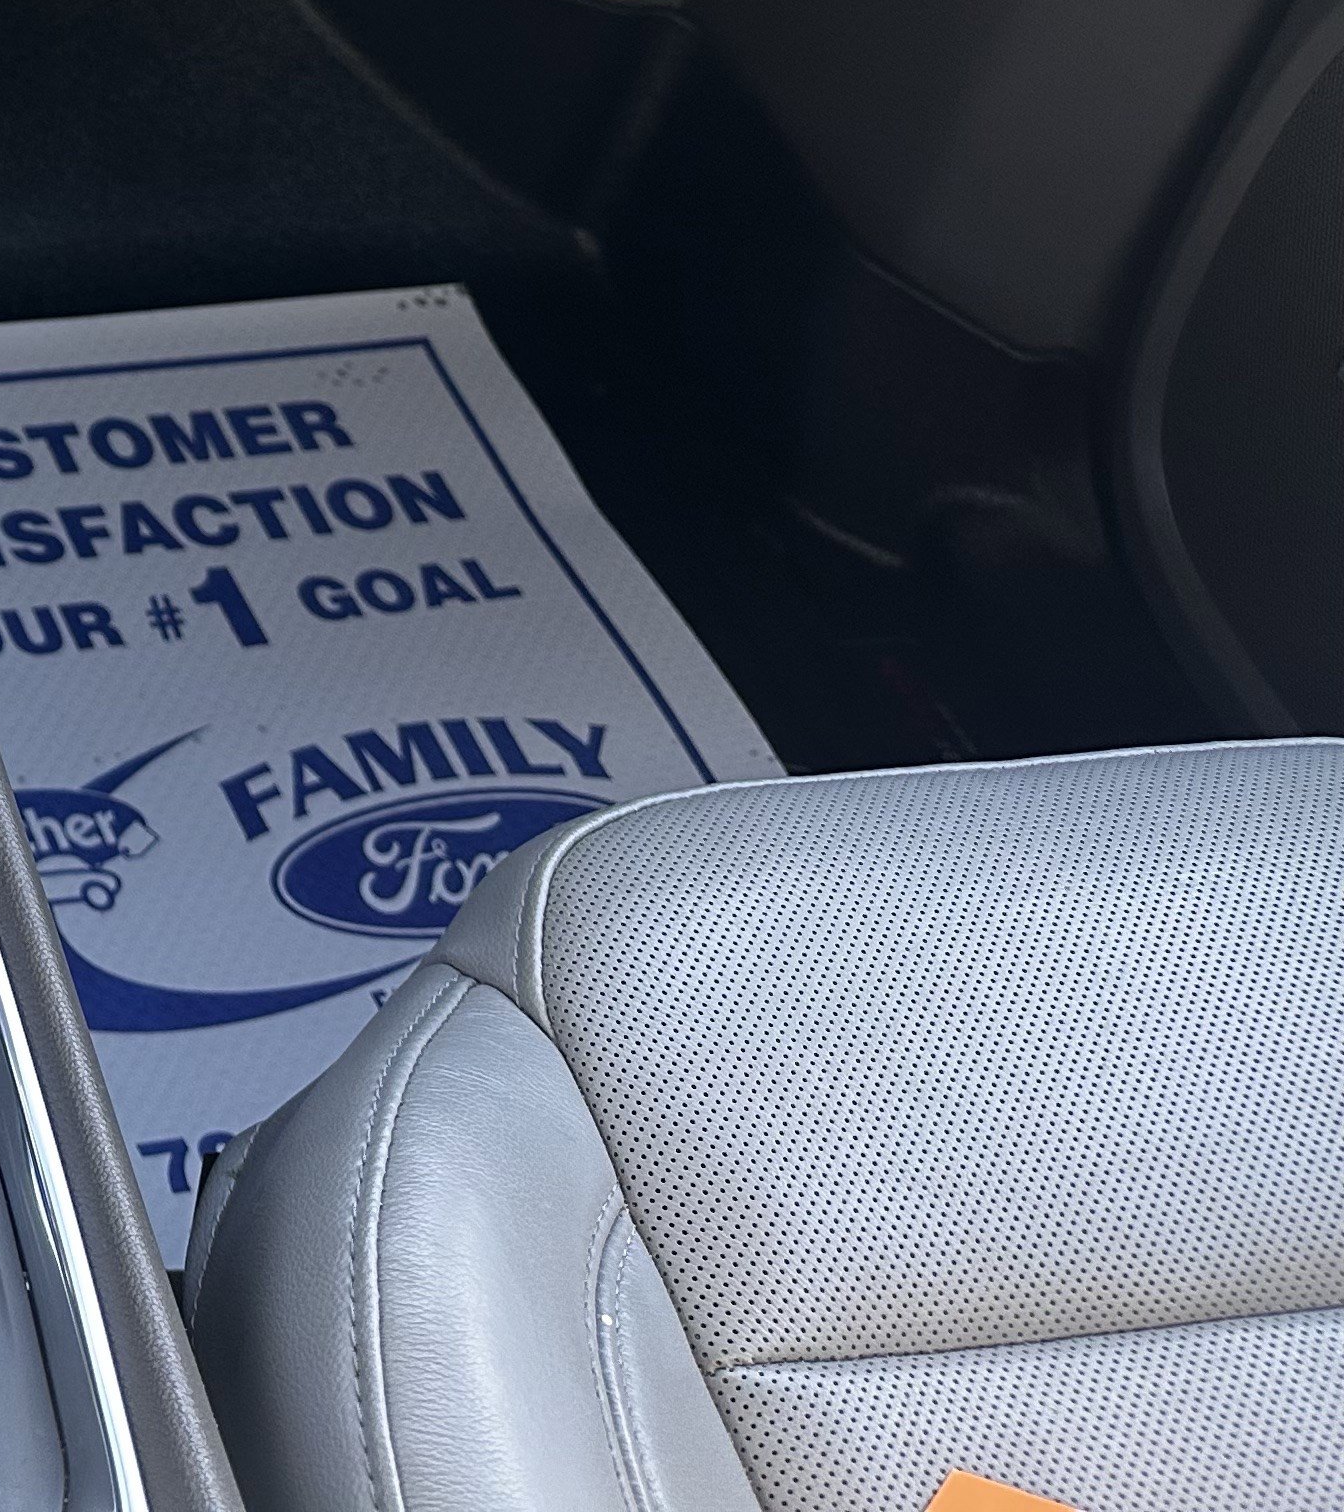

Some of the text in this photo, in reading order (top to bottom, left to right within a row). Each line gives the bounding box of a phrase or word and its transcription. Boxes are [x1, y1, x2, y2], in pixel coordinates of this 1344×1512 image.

[296, 558, 523, 623] GOAL
[219, 715, 613, 840] FAMILY
[23, 807, 116, 853] her
